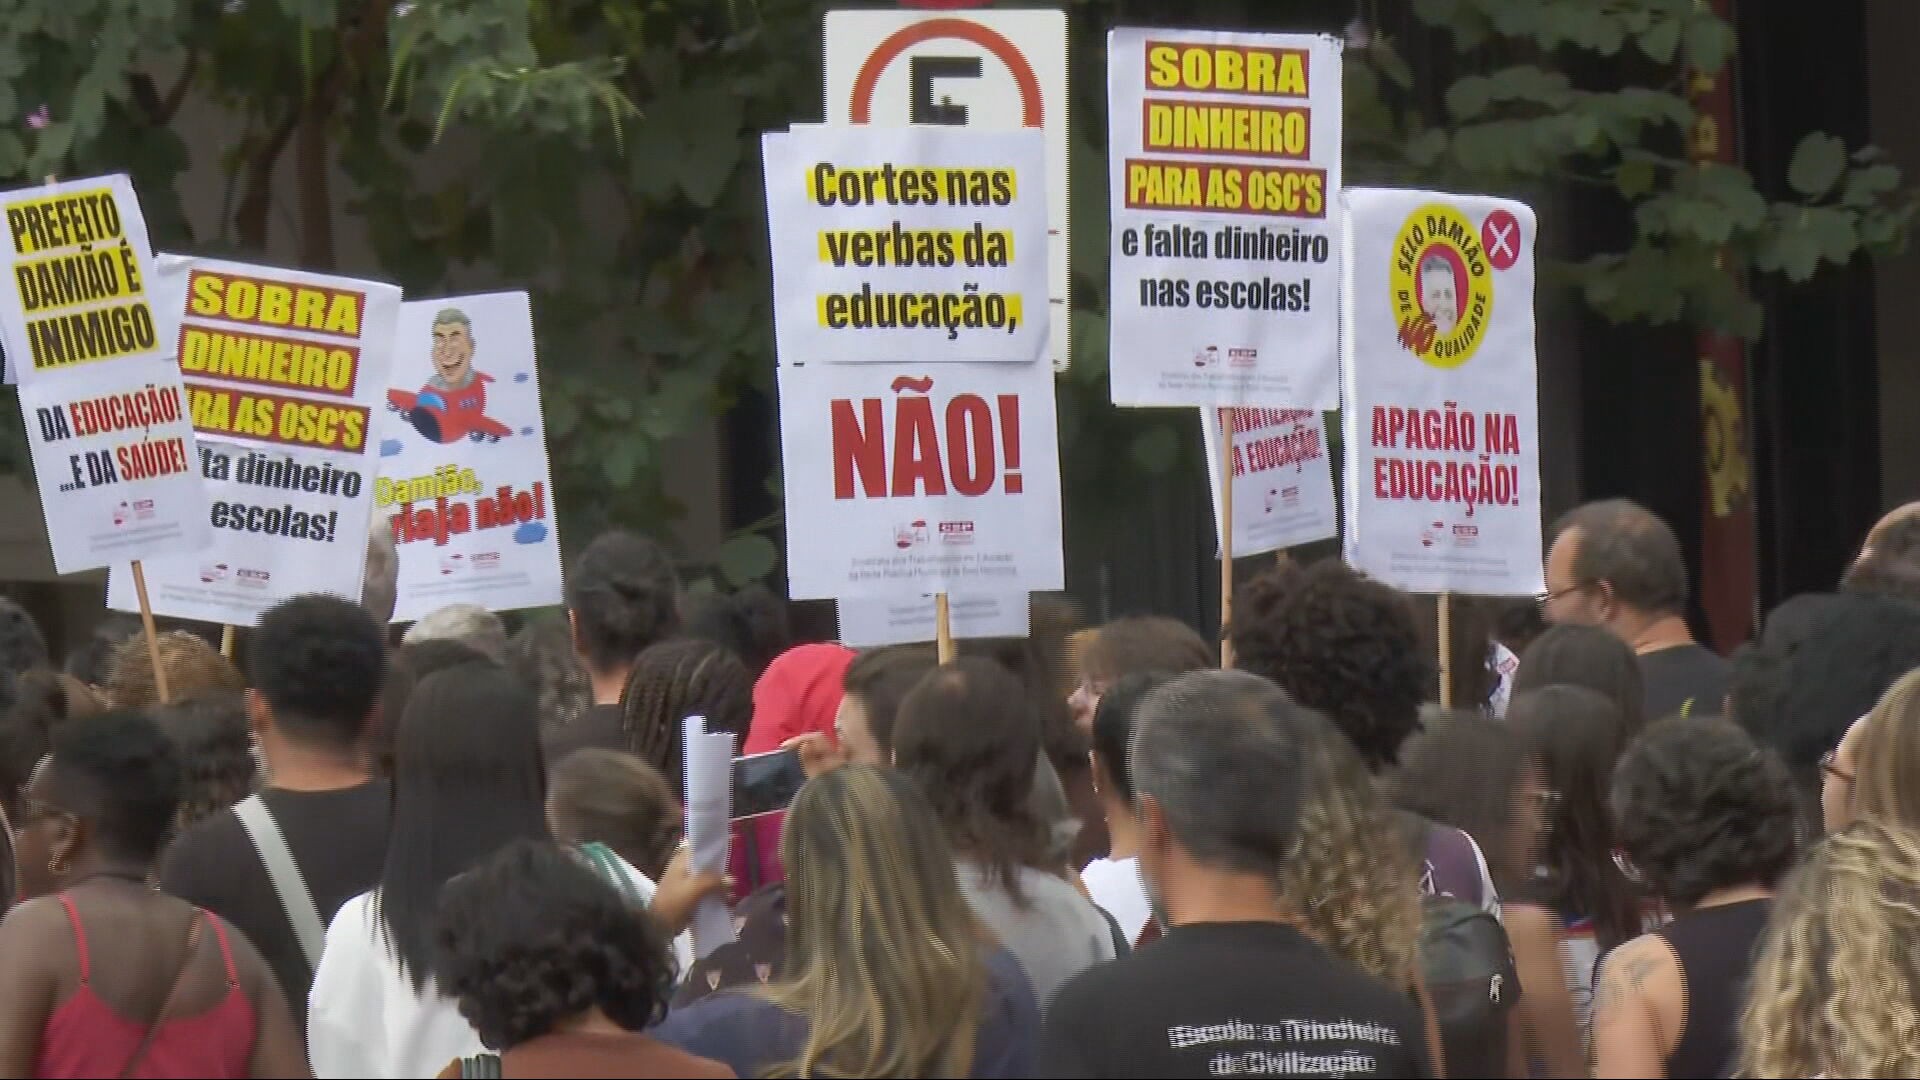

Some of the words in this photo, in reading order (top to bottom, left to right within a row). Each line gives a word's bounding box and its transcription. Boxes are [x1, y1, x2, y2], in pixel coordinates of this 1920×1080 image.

[1150, 46, 1306, 94] SOBRA
[1149, 104, 1305, 154] DINHEIRO
[815, 162, 938, 207] Cortes
[946, 169, 1011, 207] nas
[1129, 165, 1203, 206] PARA
[1206, 169, 1242, 208] AS
[1248, 172, 1322, 213] OSC'S
[7, 192, 121, 253] PREFEITO
[825, 221, 955, 267] verbas
[963, 222, 1008, 267] da
[1122, 228, 1138, 257] e
[1144, 224, 1208, 259] falta
[1215, 225, 1329, 263] dinheiro
[1397, 222, 1425, 276] SELO
[1426, 214, 1486, 278] DAMIÃO
[16, 245, 119, 311] DAMIÃO
[119, 238, 141, 293] É
[1140, 278, 1189, 308] nas
[1196, 278, 1311, 312] escolas!
[190, 274, 359, 337] SOBRA
[825, 283, 1017, 340] educação,
[1434, 291, 1487, 358] QUALIDADE
[26, 303, 155, 370] INIMIGO
[181, 329, 354, 391] DINHEIRO
[37, 401, 71, 442] DA
[70, 384, 181, 442] EDUCAÇÃO!
[186, 388, 229, 432] RA
[234, 397, 275, 438] AS
[278, 402, 364, 450] OSC'S
[830, 375, 1023, 500] NÃO!
[1371, 401, 1476, 454] APAGÃO
[1484, 413, 1519, 456] NA
[60, 455, 86, 492] ...E
[87, 449, 117, 487] DA
[116, 436, 188, 481] SAÚDE!
[236, 451, 361, 498] dinheiro
[1246, 424, 1322, 475] EDUCAÇÃO!
[375, 463, 483, 507] Damião,
[475, 482, 548, 530] não!
[1373, 452, 1519, 518] EDUCAÇÃO!
[211, 499, 338, 543] escolas!
